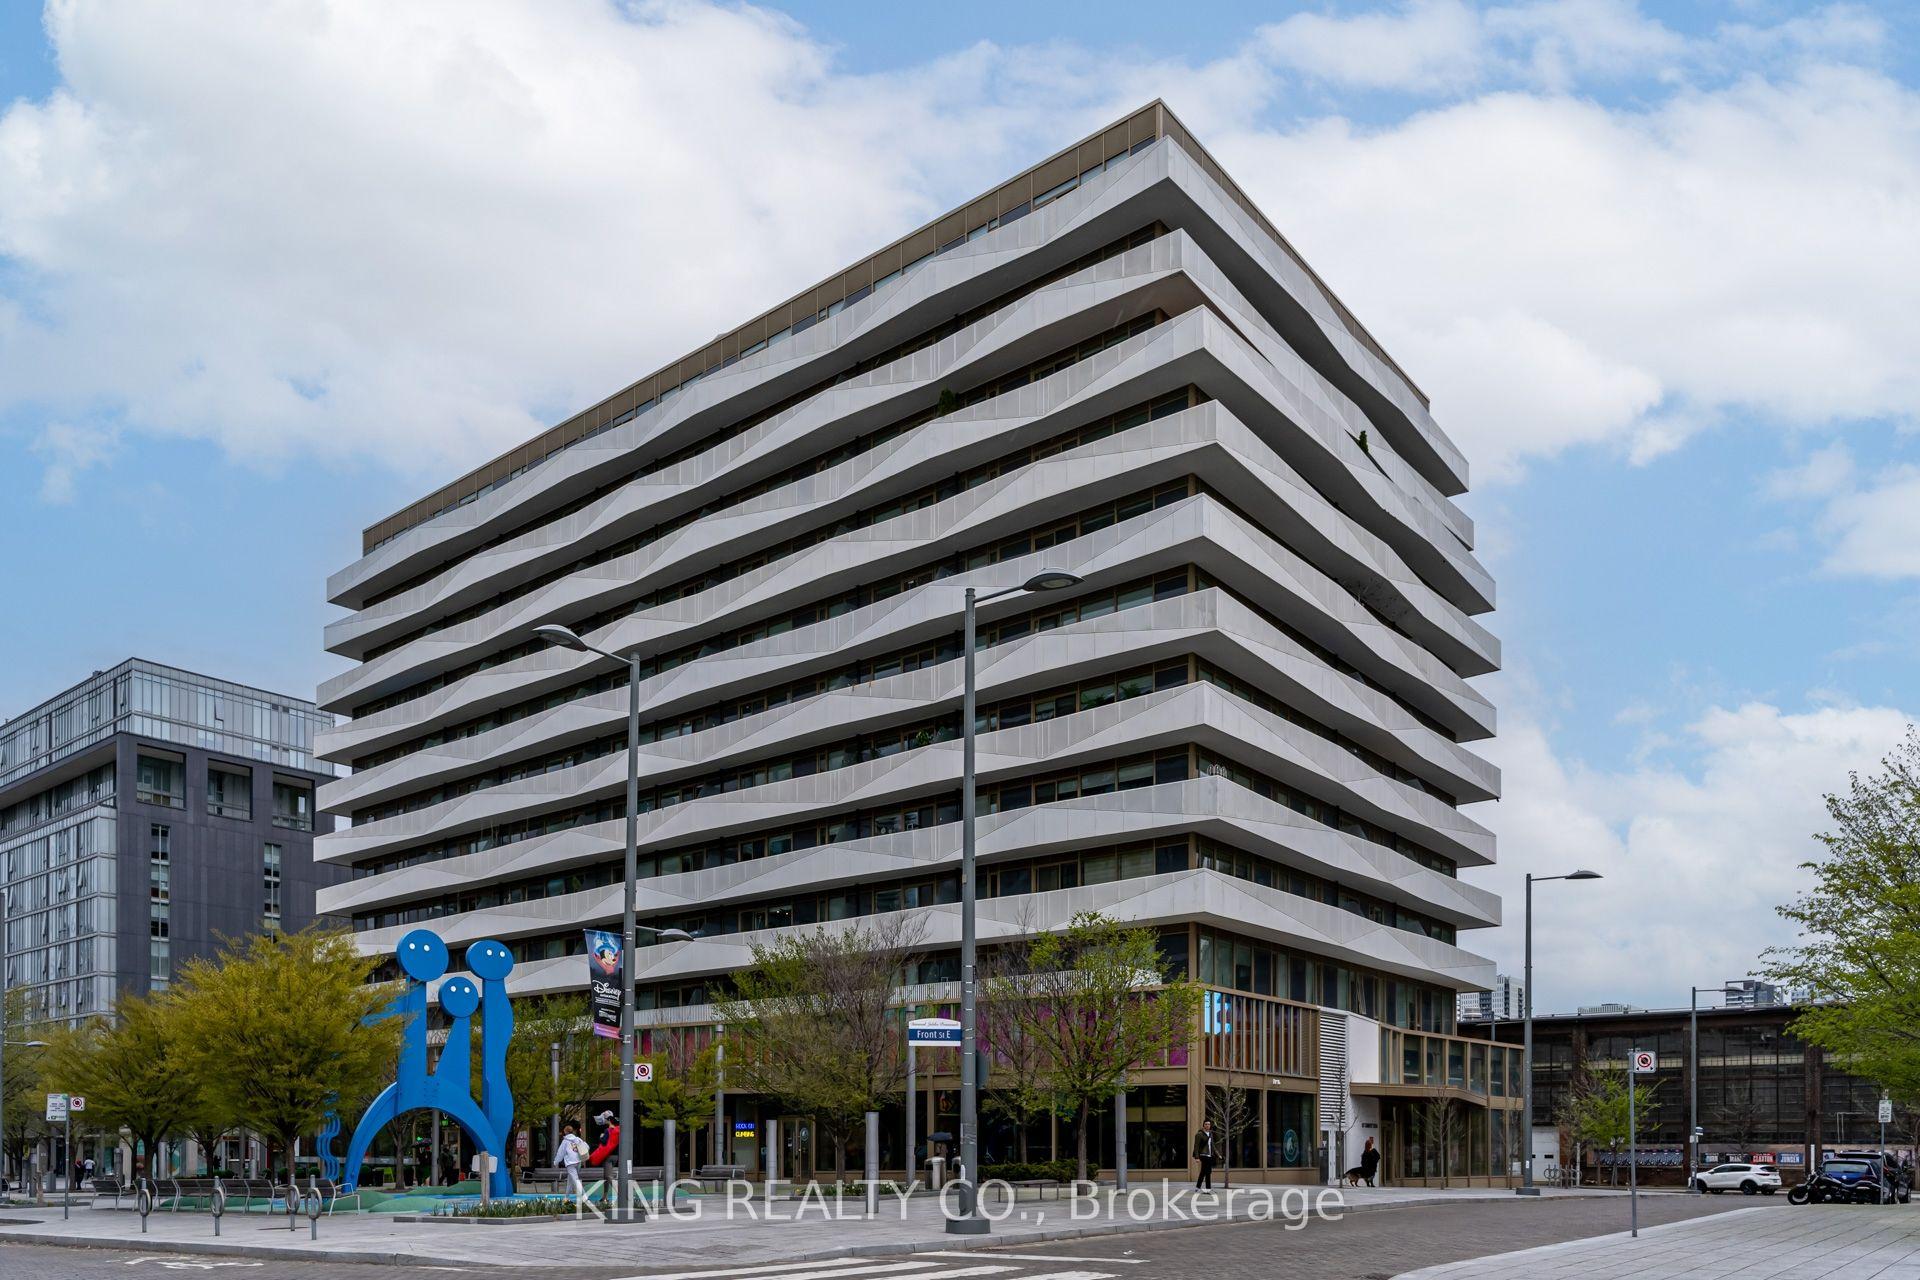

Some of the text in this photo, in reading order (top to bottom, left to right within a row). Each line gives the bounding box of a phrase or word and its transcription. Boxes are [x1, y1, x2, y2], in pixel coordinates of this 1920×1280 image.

[592, 979, 622, 1001] Disney
[917, 1030, 937, 1039] Front
[946, 1030, 951, 1039] E
